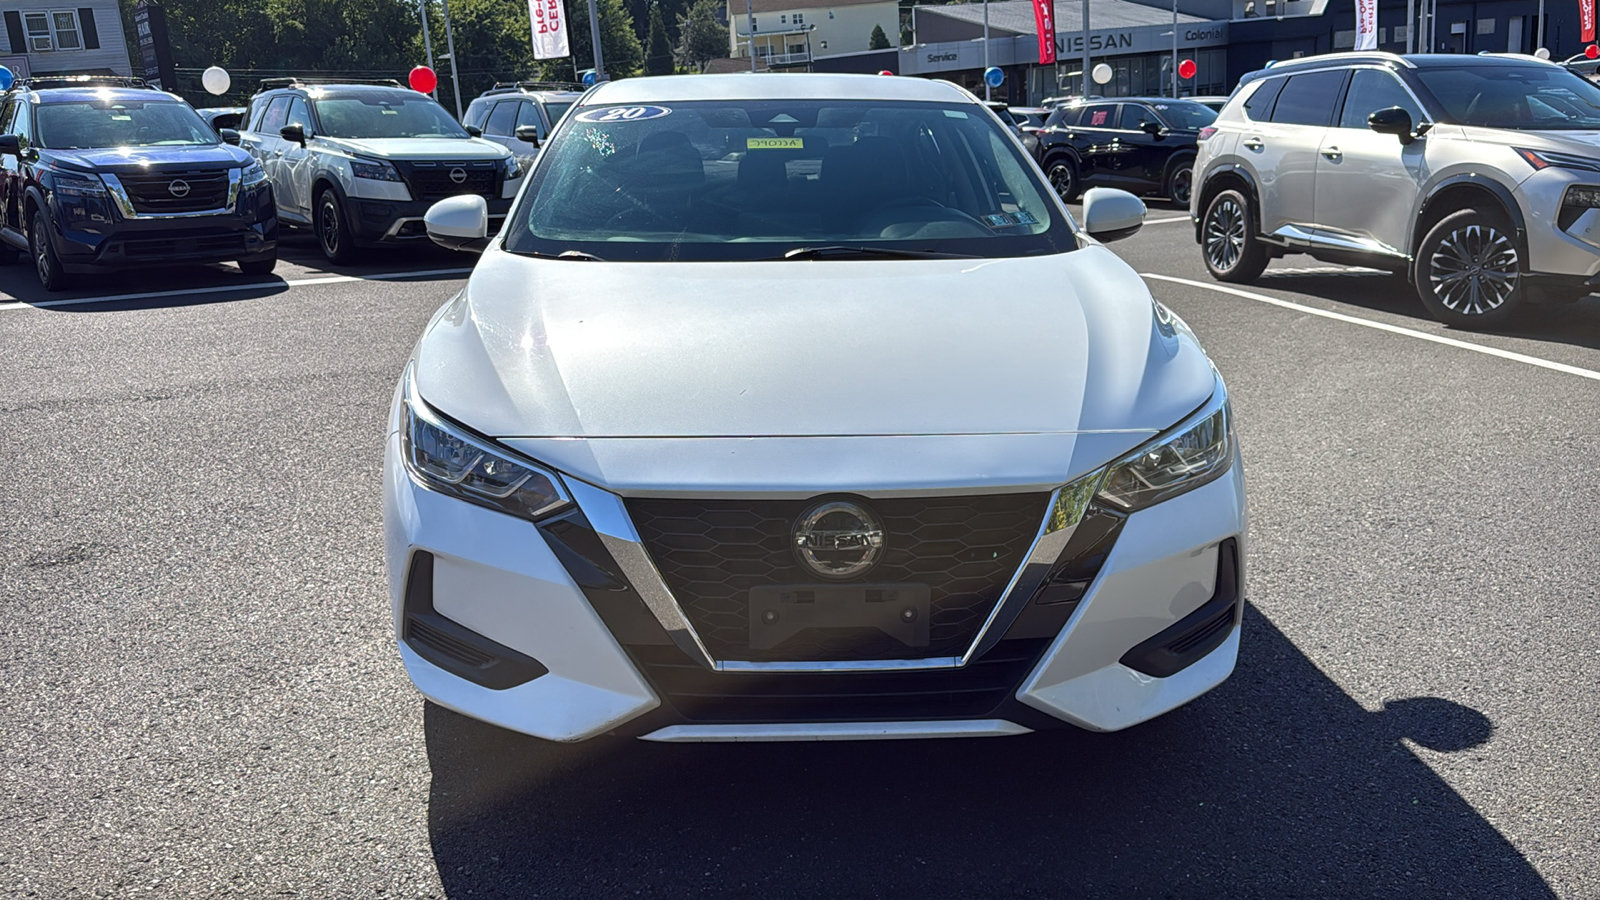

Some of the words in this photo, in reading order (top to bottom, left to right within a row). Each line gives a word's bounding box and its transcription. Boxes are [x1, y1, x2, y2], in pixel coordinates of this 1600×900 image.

[1185, 28, 1223, 41] Colonial
[1055, 33, 1132, 53] NISSAN
[927, 51, 958, 63] Service
[600, 107, 647, 120] 20
